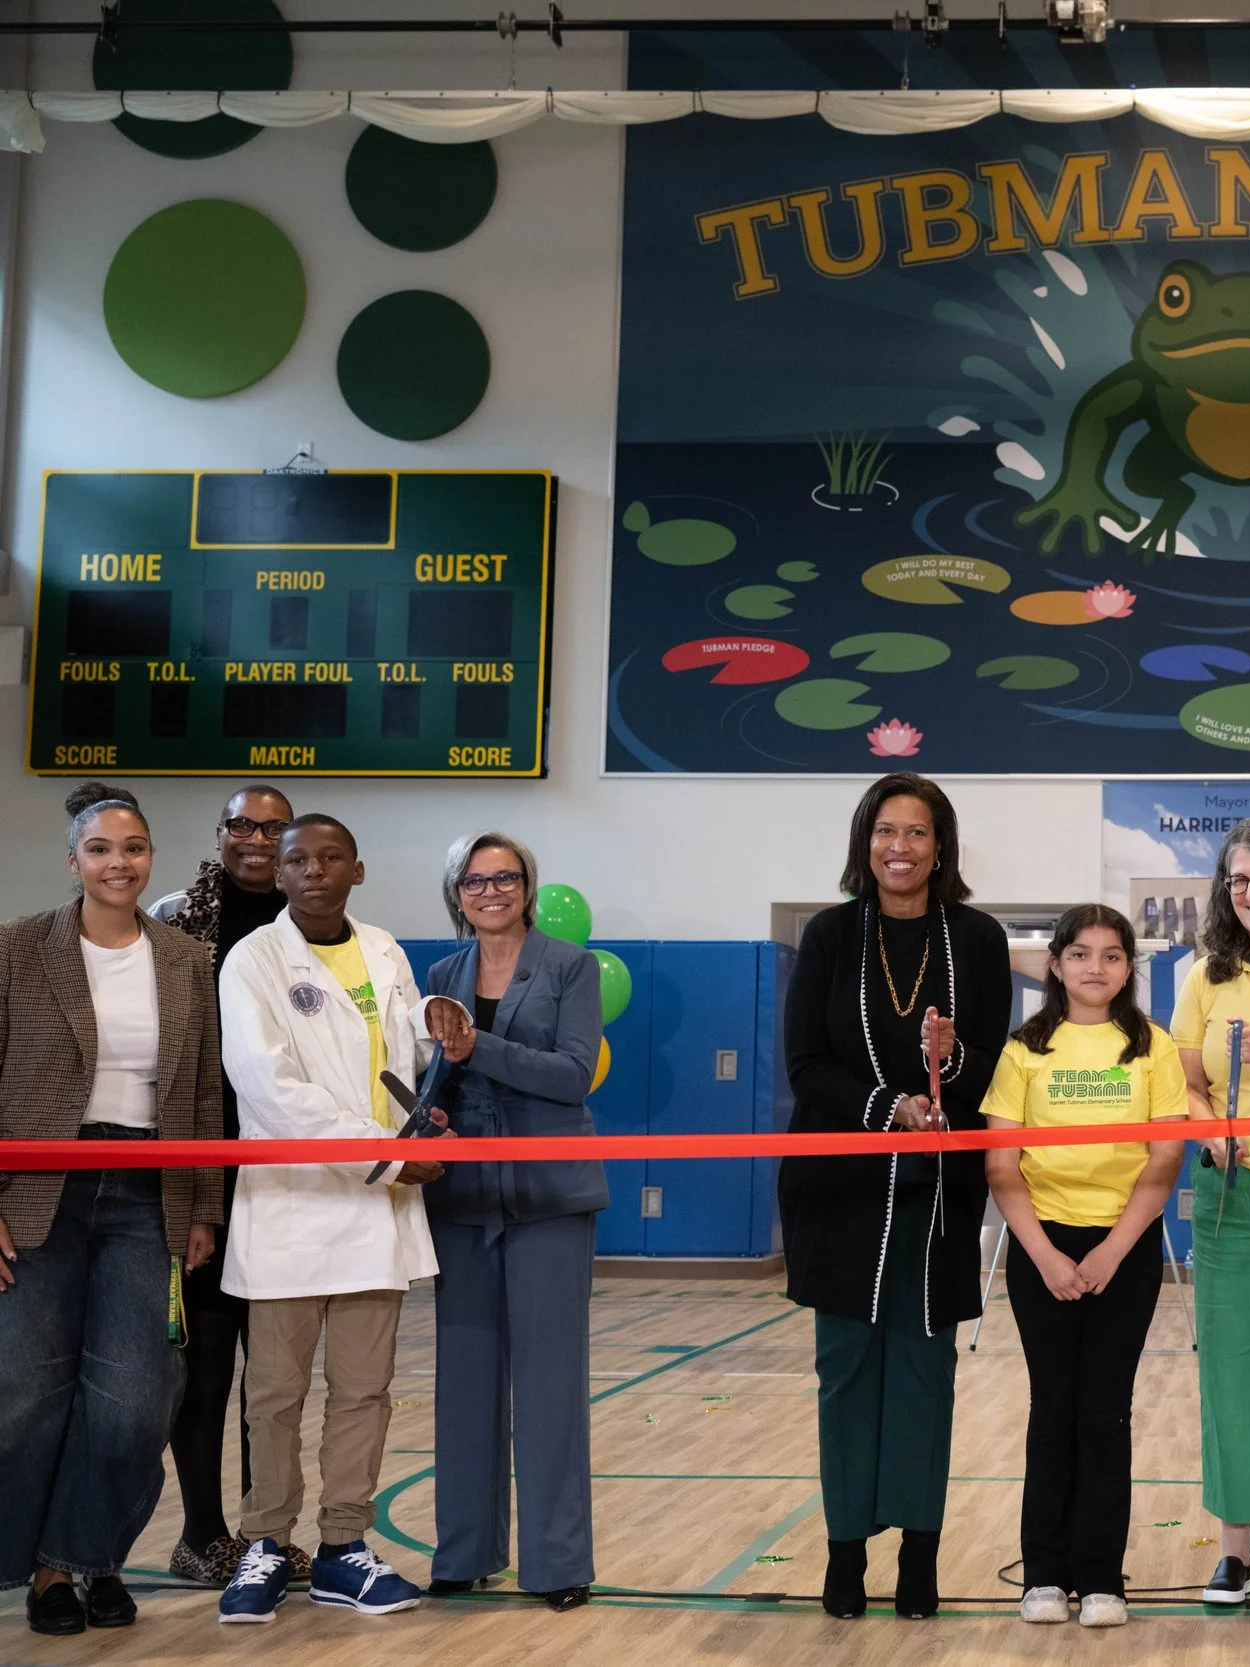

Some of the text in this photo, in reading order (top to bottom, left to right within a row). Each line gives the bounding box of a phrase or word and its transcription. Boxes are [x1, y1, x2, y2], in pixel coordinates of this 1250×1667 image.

[80, 554, 162, 582] HOME
[414, 553, 508, 582] GUEST
[902, 560, 920, 569] WILL
[956, 561, 975, 570] BEST
[256, 571, 325, 591] PERIOD
[886, 572, 916, 582] TODAY
[967, 572, 986, 582] DAY
[702, 643, 776, 653] TUBMAN PLEDGE
[60, 662, 121, 682] FOULS
[147, 663, 196, 682] T.O.L.
[225, 663, 353, 682] PLAYER FOUL
[378, 663, 427, 683] T.O.L.
[452, 663, 514, 682] FOULS
[1196, 725, 1228, 741] OTHERS
[1230, 735, 1250, 744] AND
[1201, 716, 1219, 729] WILL
[1220, 722, 1243, 734] LOVE
[55, 746, 117, 765] SCORE
[250, 747, 315, 766] MATCH
[448, 746, 512, 766] SCORE
[1204, 795, 1249, 811] Mayor
[1048, 1082, 1131, 1098] TUBMAN
